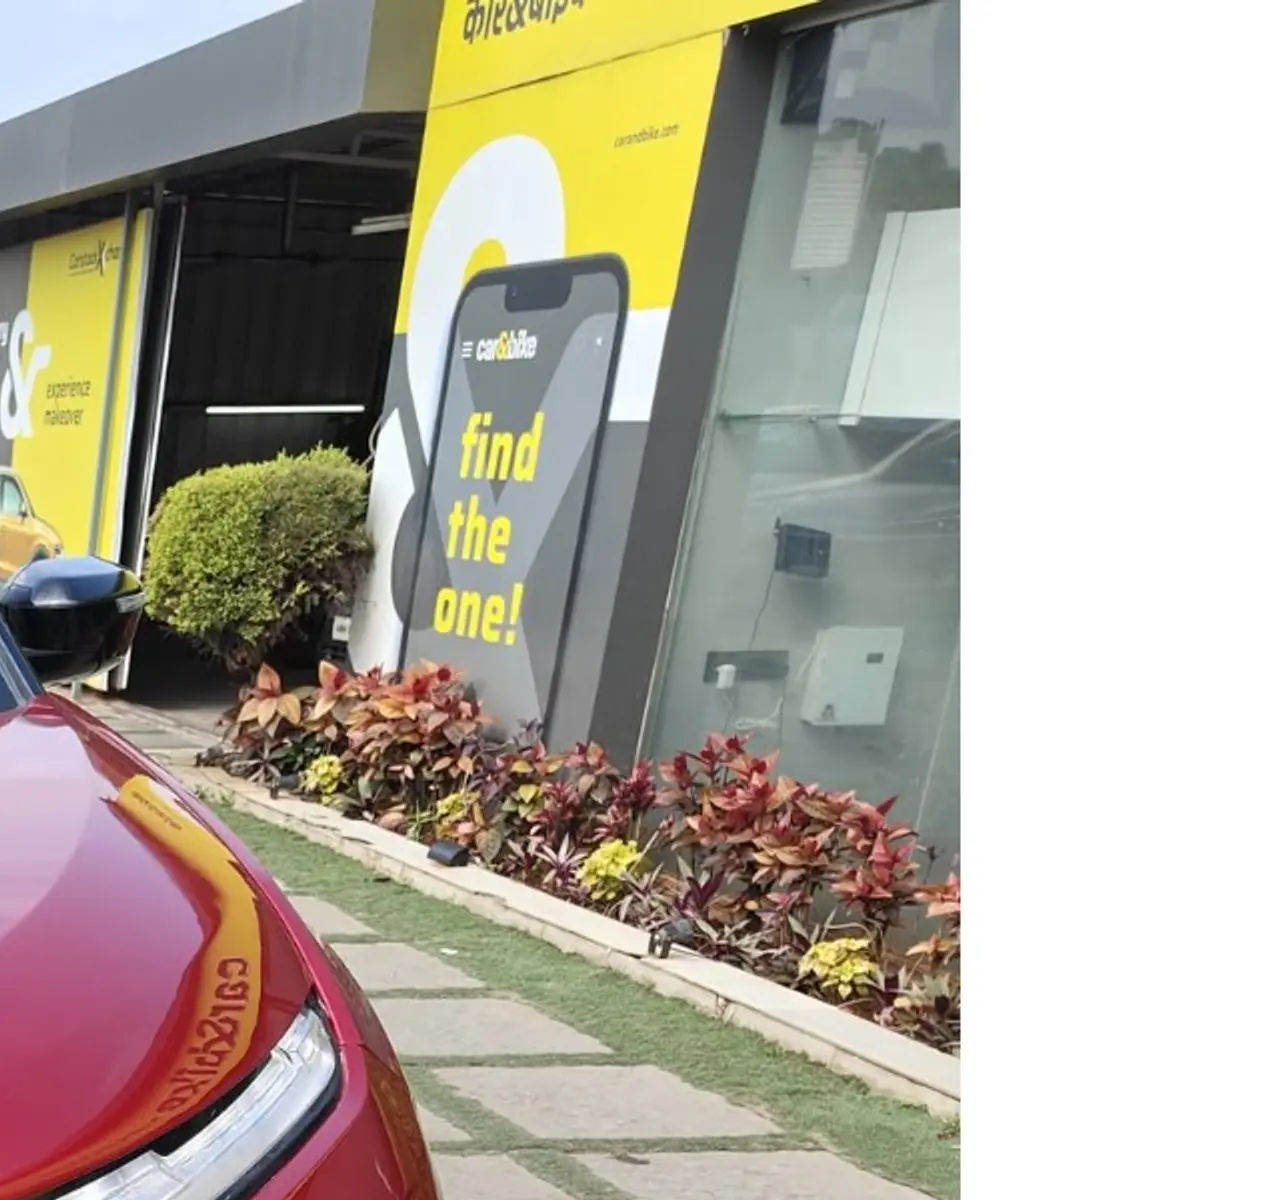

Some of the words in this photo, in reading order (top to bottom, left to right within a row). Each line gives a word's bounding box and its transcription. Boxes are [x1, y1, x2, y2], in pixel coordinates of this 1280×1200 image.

[613, 124, 678, 148] carandbike.com
[476, 329, 538, 361] car&bike
[46, 380, 91, 403] experience
[43, 408, 84, 427] makeover
[459, 411, 545, 482] find
[446, 495, 512, 564] the
[433, 582, 524, 645] one!
